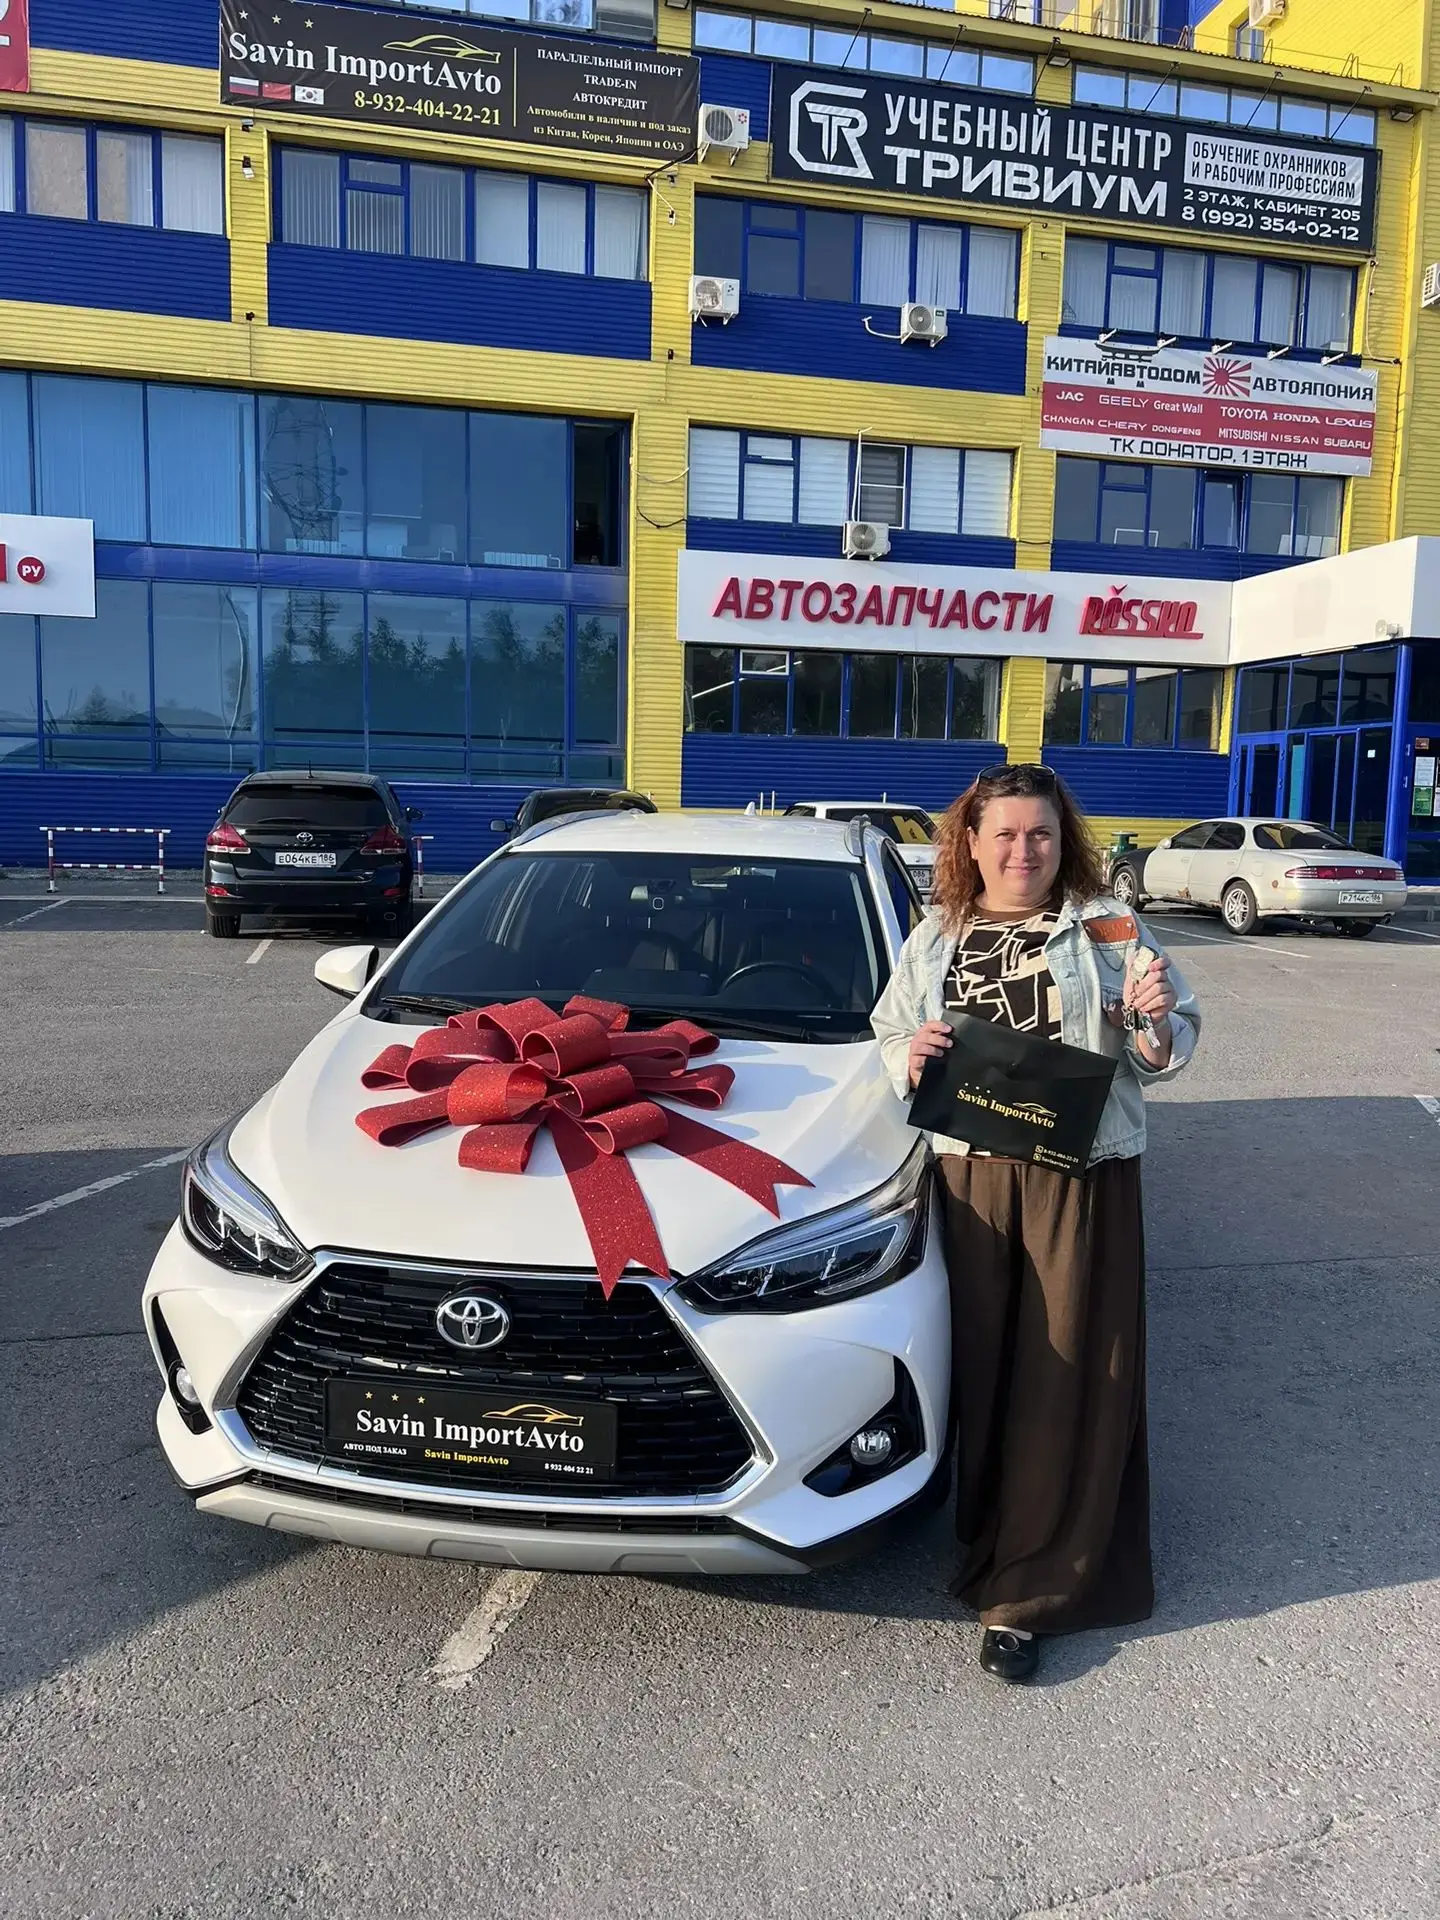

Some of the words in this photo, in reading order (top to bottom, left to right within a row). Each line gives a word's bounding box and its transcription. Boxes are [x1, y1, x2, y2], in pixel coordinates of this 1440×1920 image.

[229, 32, 315, 70] Savin
[325, 45, 502, 95] ImportAvto
[537, 49, 632, 70] ПАРАЛЛЕЛЬНЫЙ
[635, 62, 683, 77] ИМПОРТ
[584, 74, 637, 90] TRADE-IN
[354, 90, 500, 125] 8-932-404-22-21
[572, 92, 648, 110] АВТОКРЕДИТ
[527, 106, 586, 121] Автомобили
[588, 114, 594, 122] в
[597, 116, 637, 128] наличии
[648, 122, 665, 132] под
[666, 125, 691, 135] заказ
[884, 93, 1052, 156] УЧЕБНЫЙ
[1066, 119, 1172, 171] ЦЕНТР
[533, 126, 544, 135] из
[546, 126, 579, 140] Китая,
[582, 130, 614, 144] Кореи,
[615, 135, 652, 148] Японии
[662, 140, 684, 152] ОАЭ
[1192, 141, 1260, 166] ОБУЧЕНИЕ
[1263, 151, 1347, 178] ОХРАННИКОВ
[884, 145, 1168, 218] ТРИВИУМ
[1191, 161, 1200, 178] И
[1204, 163, 1264, 187] РАБОЧИМ
[1270, 172, 1355, 199] ПРОФЕССИЯМ
[1184, 189, 1194, 200] 2
[1198, 191, 1250, 209] ЭТАЖ,
[1254, 198, 1327, 218] КАБИНЕТ
[1331, 208, 1360, 221] 205
[1181, 206, 1195, 221] 8
[1202, 207, 1254, 229] (992)
[1260, 216, 1359, 241] 354-02-12
[1047, 356, 1200, 385] КИТАЙАВТОДОМ
[1252, 377, 1373, 400] АВТОЯПОНИЯ
[1056, 391, 1084, 402] JAC
[1099, 394, 1149, 408] GEELY
[1154, 400, 1180, 412] Great
[1182, 403, 1203, 414] Wall
[1220, 406, 1268, 421] TOYOTA
[1272, 412, 1320, 424] HONDA
[1326, 417, 1372, 429] LEXUS
[1043, 414, 1094, 426] CHANGAN
[1098, 420, 1148, 431] CHERY
[1152, 425, 1201, 436] DONGFENG
[1218, 428, 1268, 442] MITSUBISHI
[1271, 434, 1319, 445] NISSAN
[1324, 438, 1371, 450] SUBARU
[1110, 438, 1135, 454] ТК
[1139, 440, 1236, 463] ДОНАТОР,
[1242, 450, 1248, 462] 1
[1252, 451, 1308, 468] ЭТАЖ
[714, 576, 1054, 633] АВТОЗАПЧАСТИ
[957, 1089, 988, 1108] Savin
[990, 1100, 1055, 1128] ImportAvto
[356, 1409, 426, 1437] Savin
[433, 1416, 584, 1452] ImportAvto
[343, 1443, 364, 1451] АВТО
[366, 1444, 382, 1454] ПОД
[383, 1447, 407, 1455] ЗАКАЗ
[424, 1449, 451, 1460] Savin
[454, 1452, 509, 1465] ImportAvto
[550, 1464, 562, 1472] 932
[576, 1466, 584, 1474] 22
